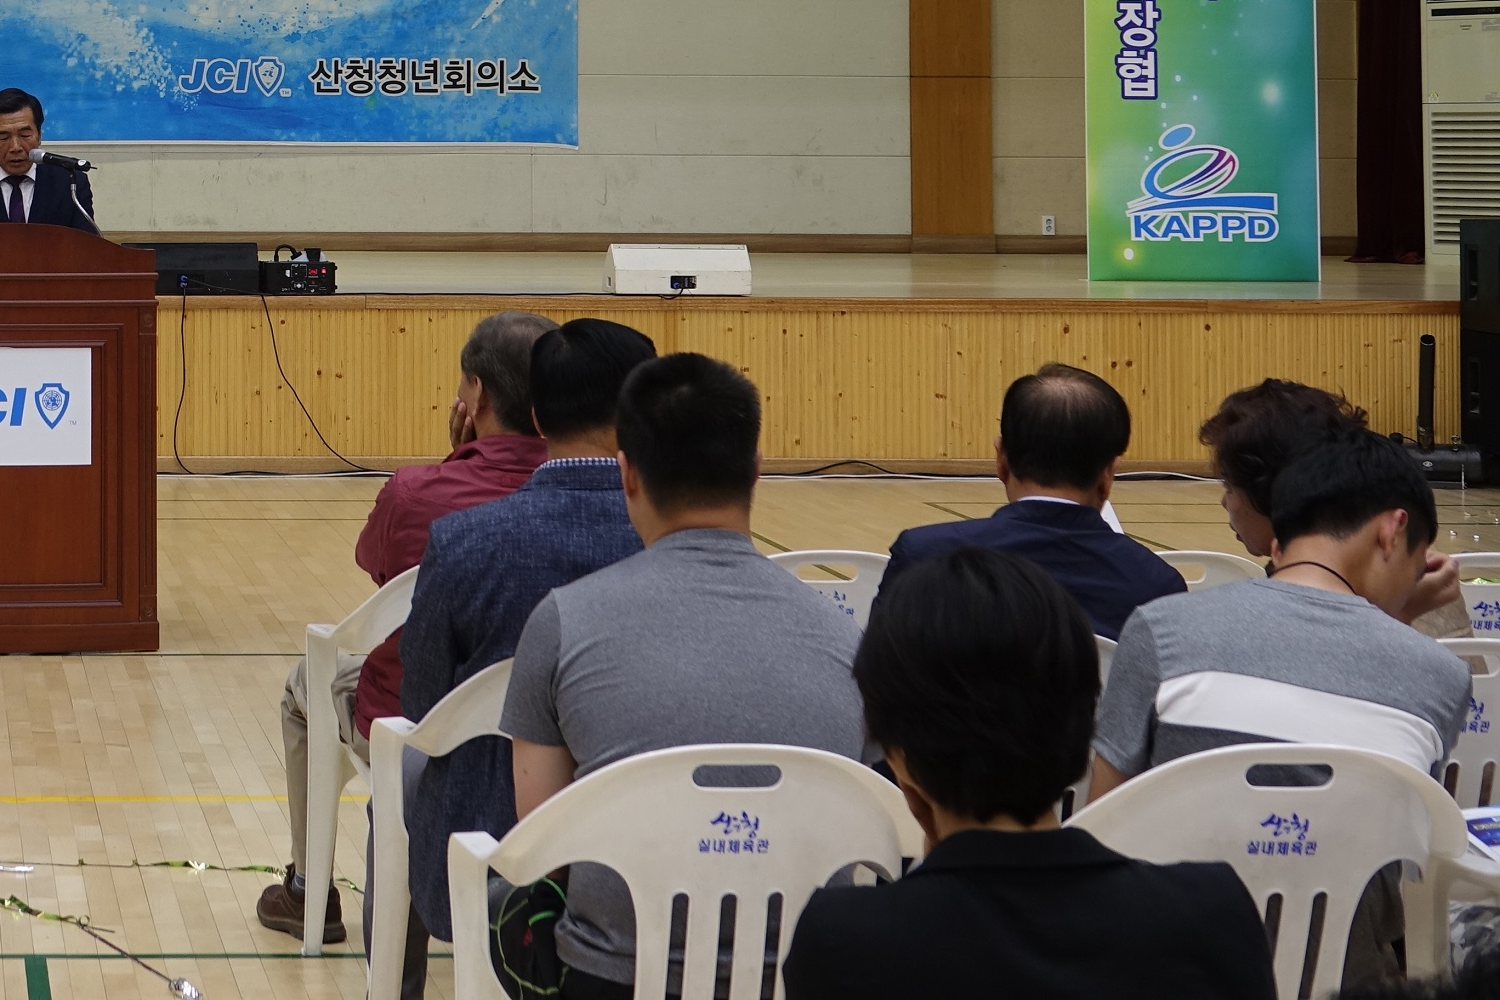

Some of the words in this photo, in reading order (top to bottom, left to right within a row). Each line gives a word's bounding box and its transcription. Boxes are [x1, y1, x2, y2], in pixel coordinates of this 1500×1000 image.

[178, 57, 251, 95] JCI
[308, 57, 541, 96] 산청청년회의소
[1132, 212, 1279, 241] KAPPD
[699, 838, 769, 854] 실내체육관
[1246, 839, 1318, 856] 실내체육관
